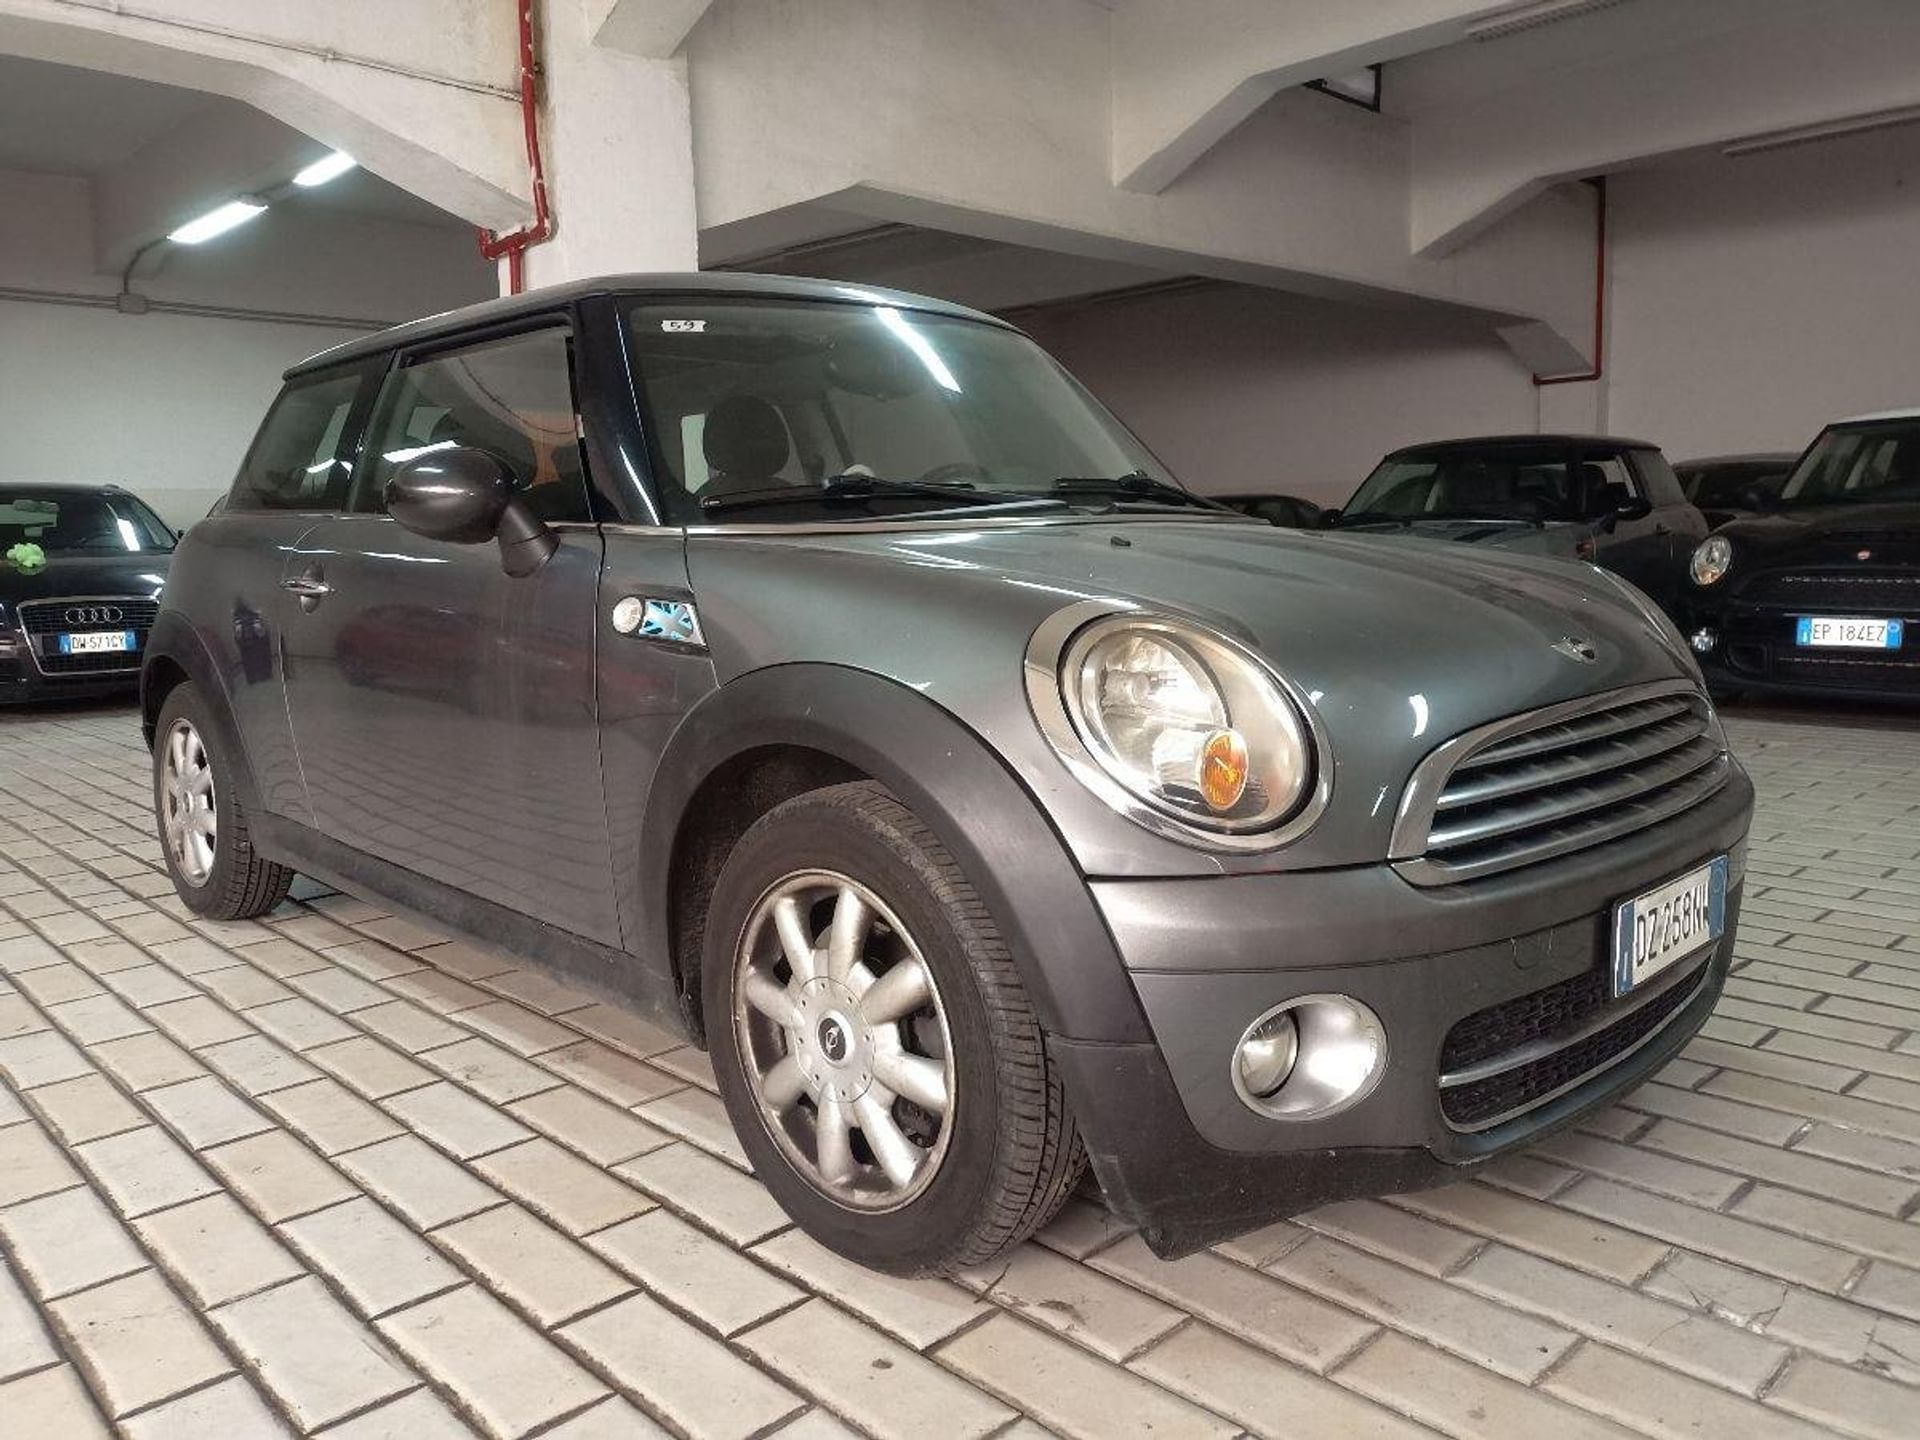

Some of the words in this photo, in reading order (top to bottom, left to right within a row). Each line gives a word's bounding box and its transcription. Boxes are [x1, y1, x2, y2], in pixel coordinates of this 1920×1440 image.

[1813, 624, 1831, 640] EP
[1840, 625, 1886, 641] 184EZ
[1636, 907, 1659, 967] DZ
